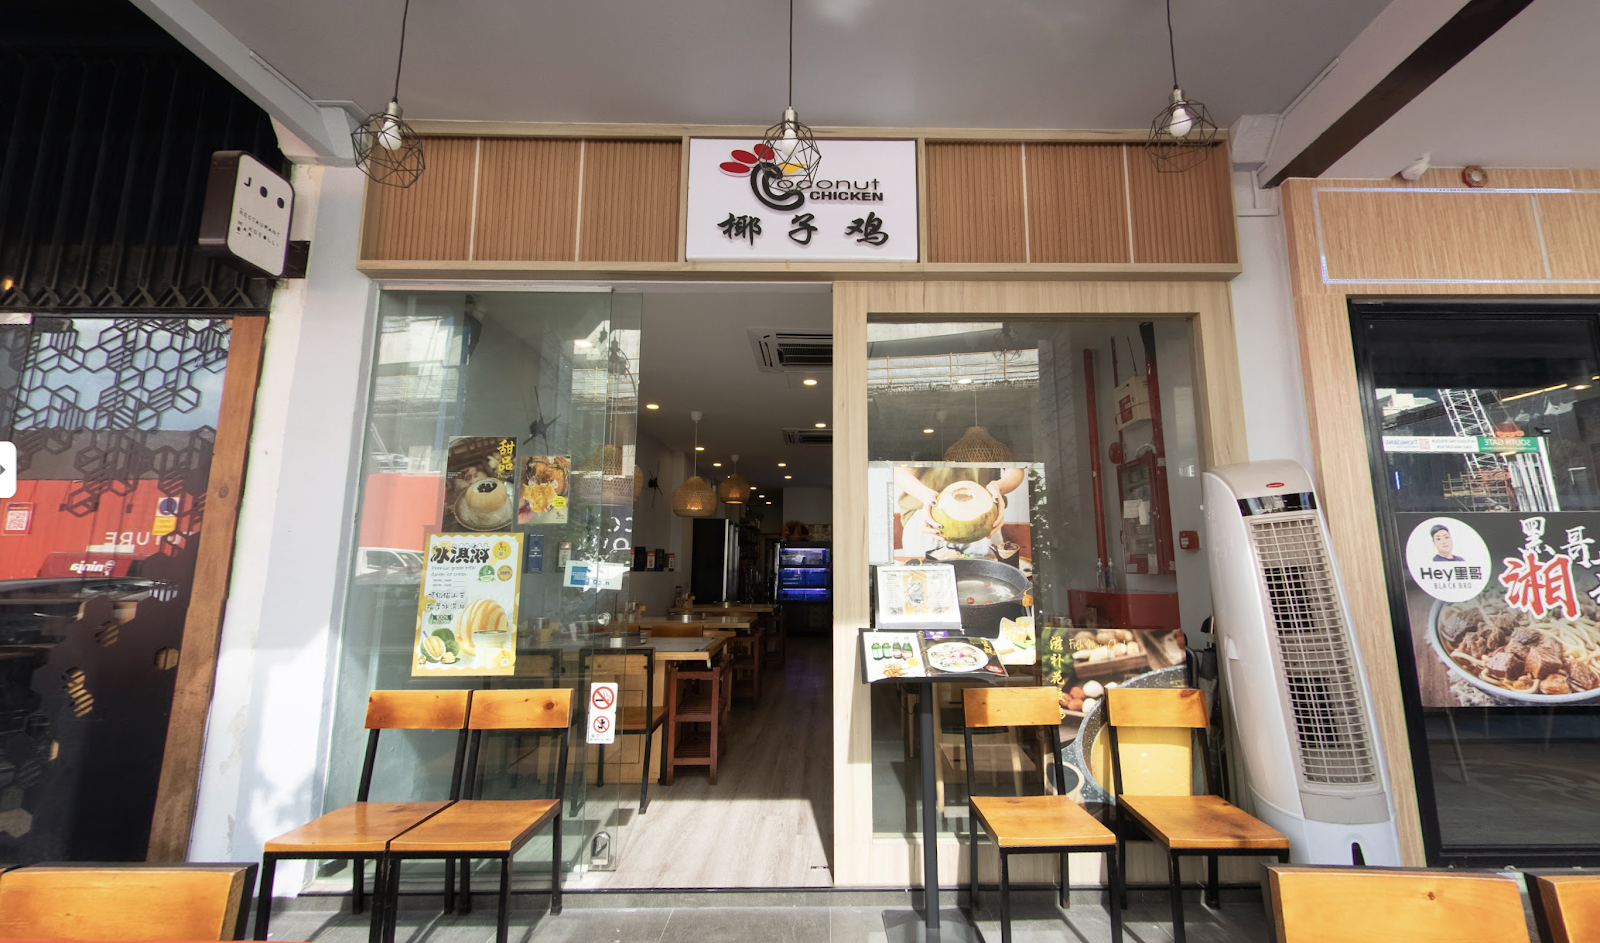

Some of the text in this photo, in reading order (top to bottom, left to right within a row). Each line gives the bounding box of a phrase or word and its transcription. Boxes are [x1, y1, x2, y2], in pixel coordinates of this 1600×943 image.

[809, 191, 884, 202] CHICKEN
[497, 439, 515, 472] 甜品
[430, 543, 490, 564] 冰淇淋
[1069, 638, 1085, 650] Fish
